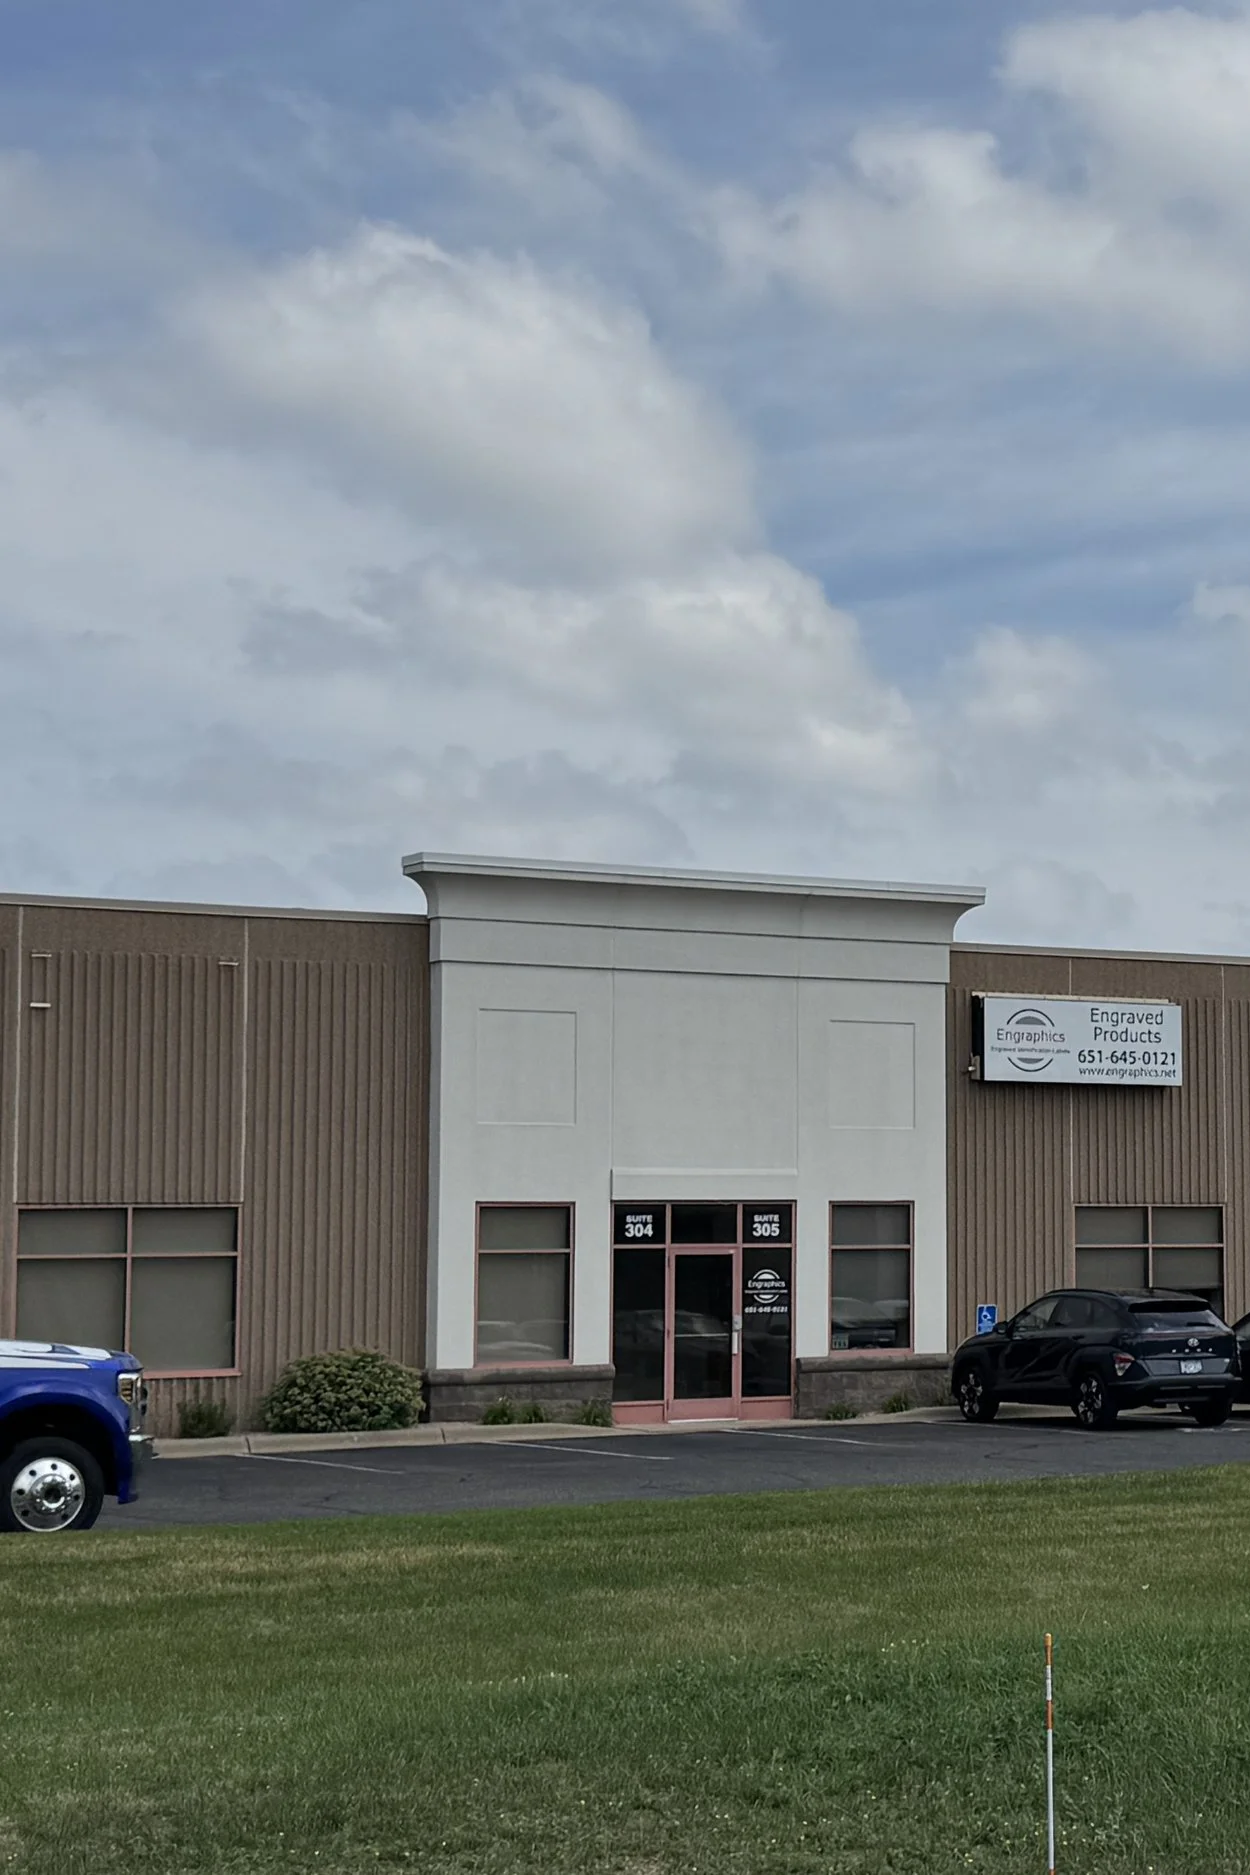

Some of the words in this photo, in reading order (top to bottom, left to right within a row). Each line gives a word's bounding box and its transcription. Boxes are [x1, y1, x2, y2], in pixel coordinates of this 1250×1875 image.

[1090, 1008, 1163, 1026] Engraved
[996, 1028, 1065, 1043] Engraphics
[1094, 1027, 1161, 1043] Products
[1078, 1050, 1176, 1065] 651-645-0121
[1079, 1066, 1176, 1079] www.engraphics.net
[626, 1214, 653, 1223] SUITE
[753, 1214, 780, 1222] SUITE
[625, 1223, 653, 1237] 304
[752, 1223, 780, 1237] 305
[748, 1280, 786, 1289] Engraphics
